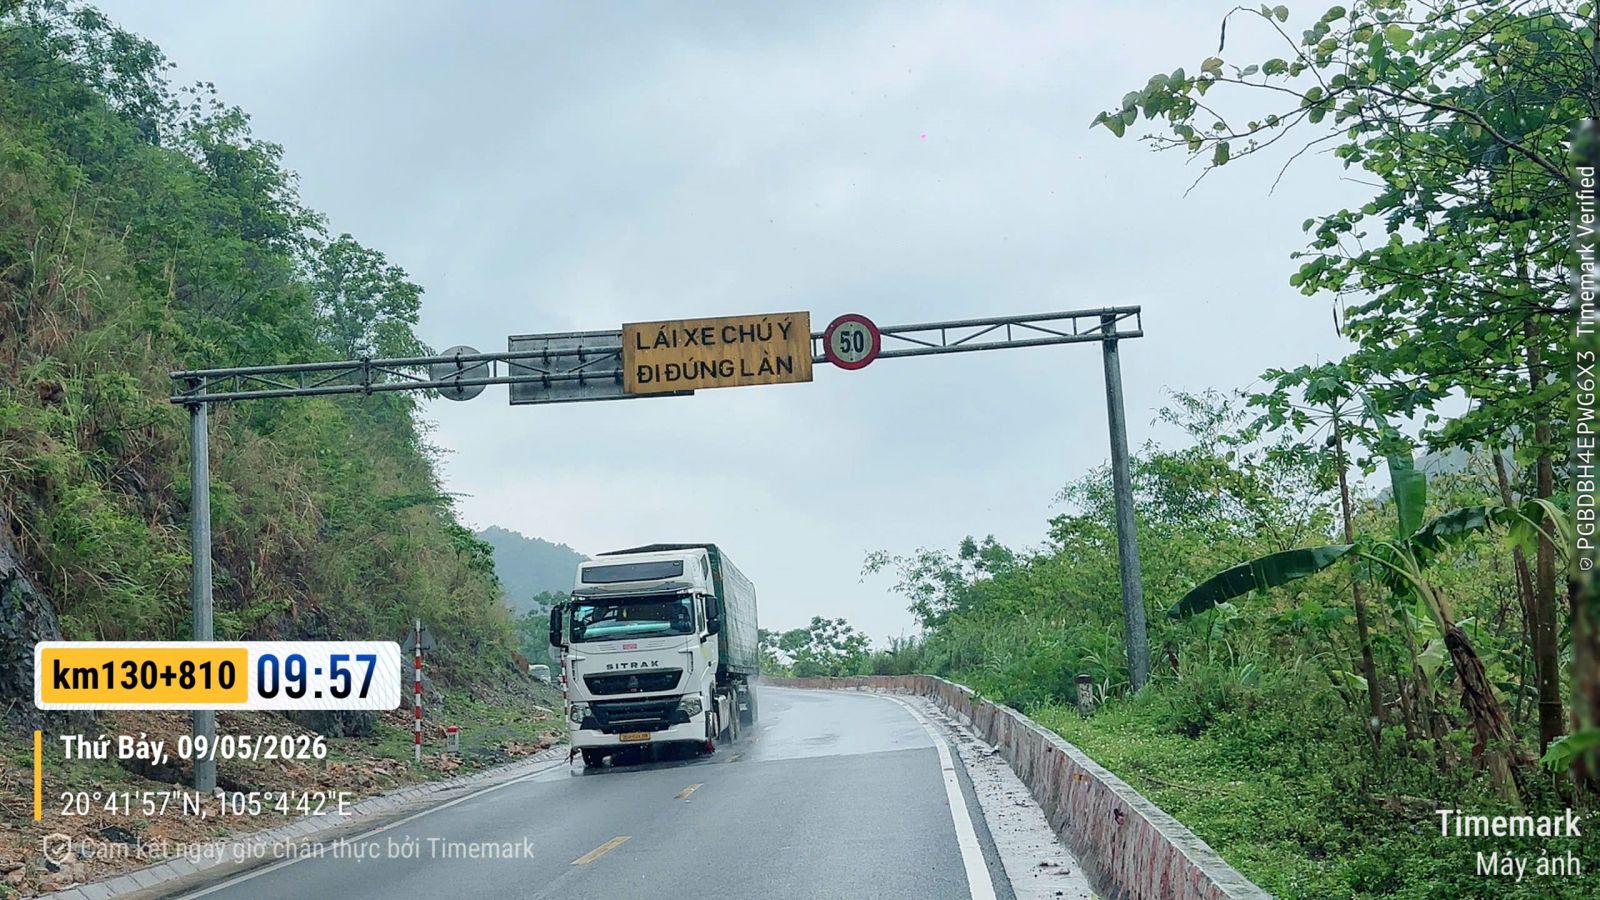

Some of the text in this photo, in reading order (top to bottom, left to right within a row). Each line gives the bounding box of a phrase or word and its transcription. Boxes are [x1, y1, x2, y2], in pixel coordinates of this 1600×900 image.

[636, 317, 792, 351] LÁI XE CHÚ Ý
[840, 330, 865, 354] 50
[637, 350, 793, 384] ĐI ĐÚNG LÀN
[606, 660, 660, 670] SITRAK
